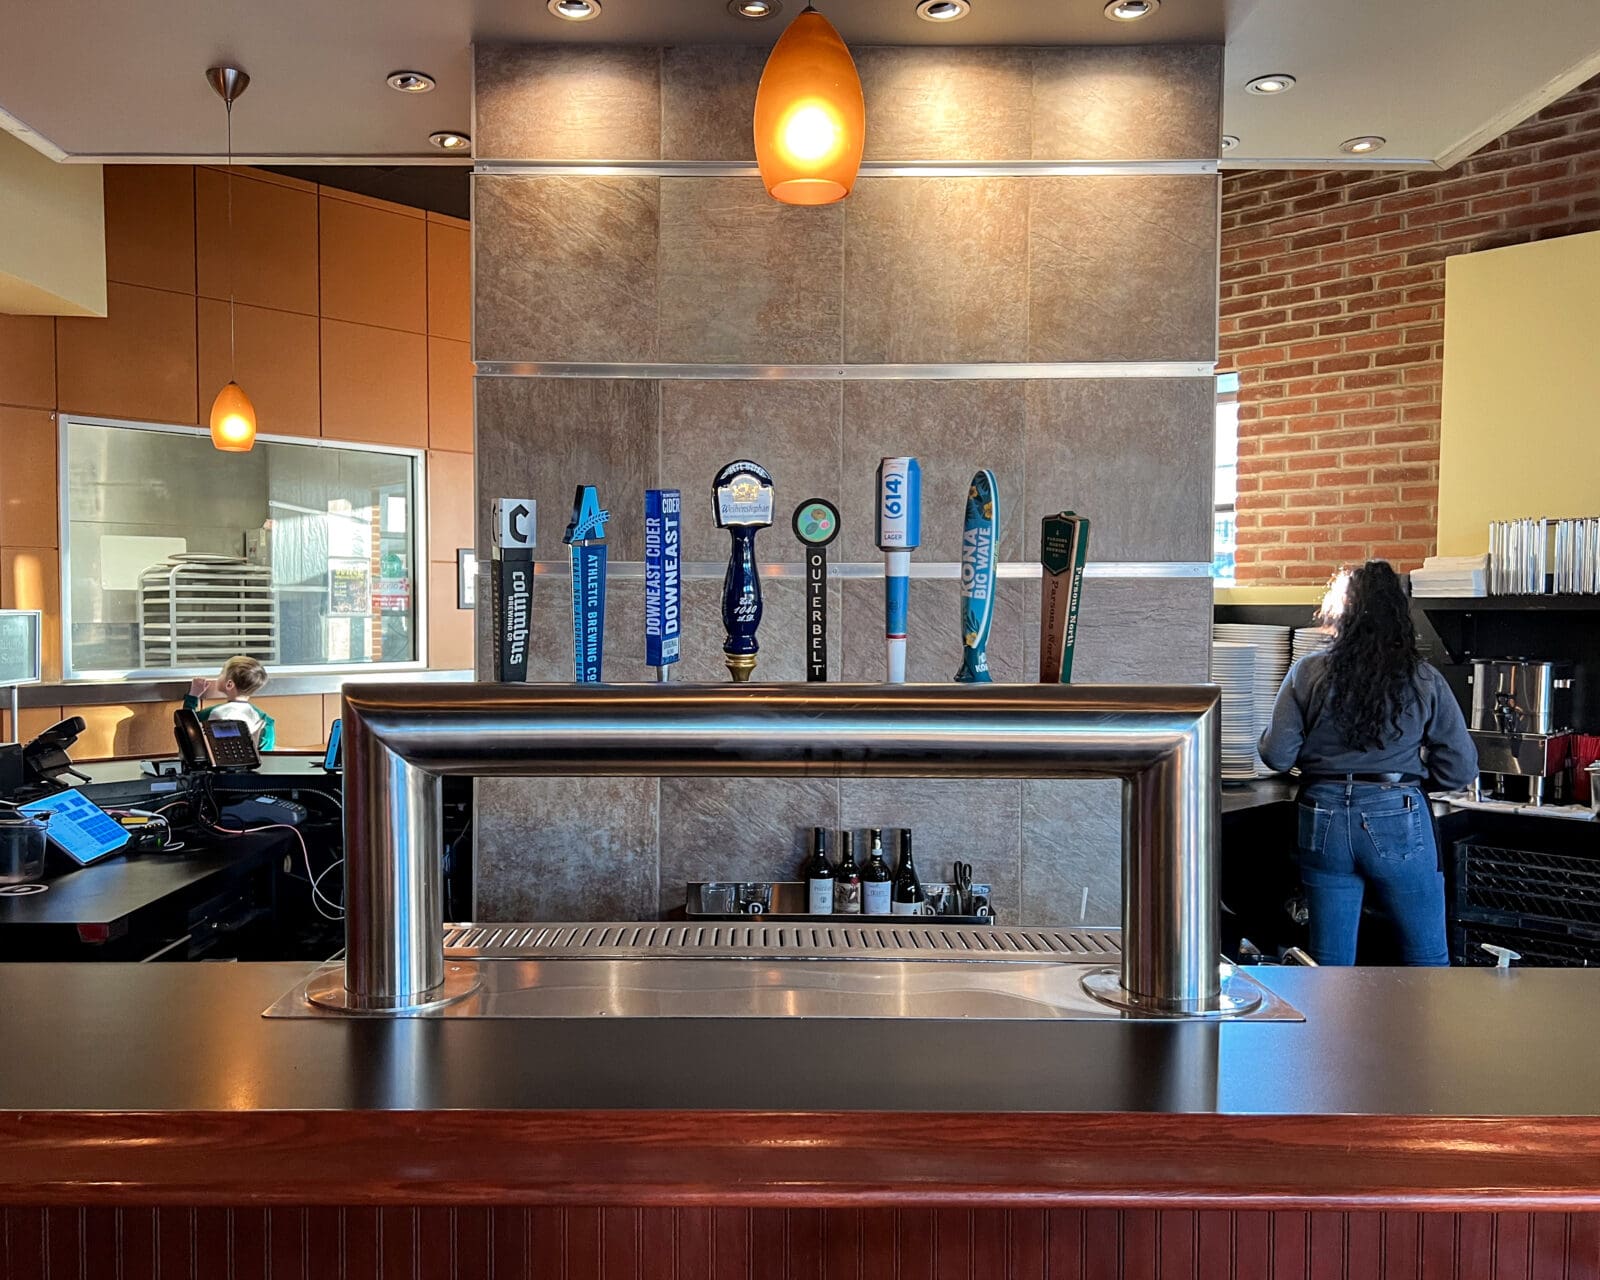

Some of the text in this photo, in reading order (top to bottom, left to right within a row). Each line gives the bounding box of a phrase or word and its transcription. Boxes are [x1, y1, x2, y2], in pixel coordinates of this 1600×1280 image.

[662, 497, 680, 514] CIDER
[884, 473, 904, 519] (614)
[572, 557, 580, 584] CRAFT
[587, 554, 598, 607] ATHLETIC
[646, 518, 661, 635] DOWNEAST CIDER
[664, 517, 679, 635] DOWNEAST
[961, 528, 978, 598] KONA
[973, 528, 991, 599] BIG WAVE
[506, 595, 515, 631] BREWING
[510, 571, 530, 665] columbus
[574, 588, 582, 658] NON-ALCOHOLIC
[587, 612, 598, 663] BREWING
[733, 605, 758, 614] 1040
[811, 555, 823, 676] OUTERBELT
[1046, 580, 1060, 669] Parsons North
[1066, 566, 1082, 647] Parsons North
